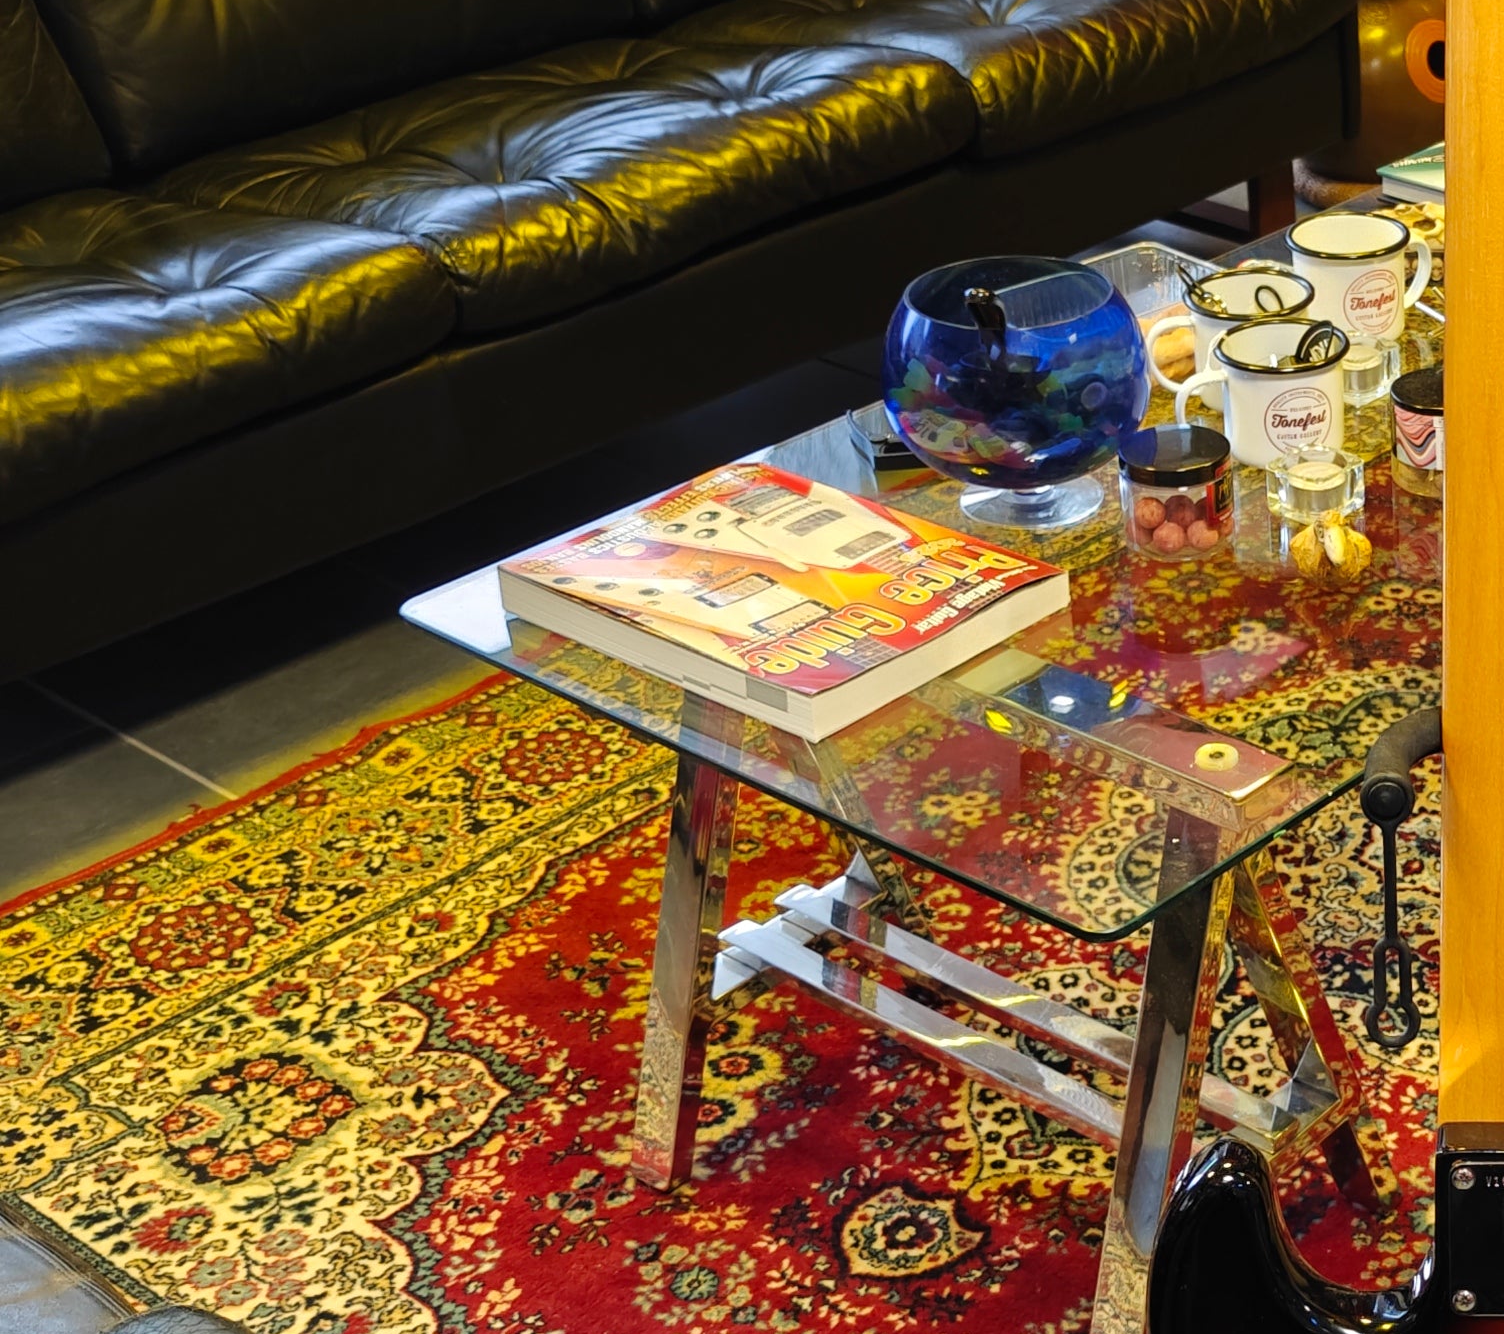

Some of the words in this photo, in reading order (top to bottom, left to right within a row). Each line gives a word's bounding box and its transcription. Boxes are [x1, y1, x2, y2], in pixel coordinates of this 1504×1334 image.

[1271, 409, 1327, 431] Tonefest
[877, 543, 1029, 605] Price
[946, 578, 1007, 608] Vintage
[910, 606, 962, 634] Guitar
[745, 604, 907, 674] Guide
